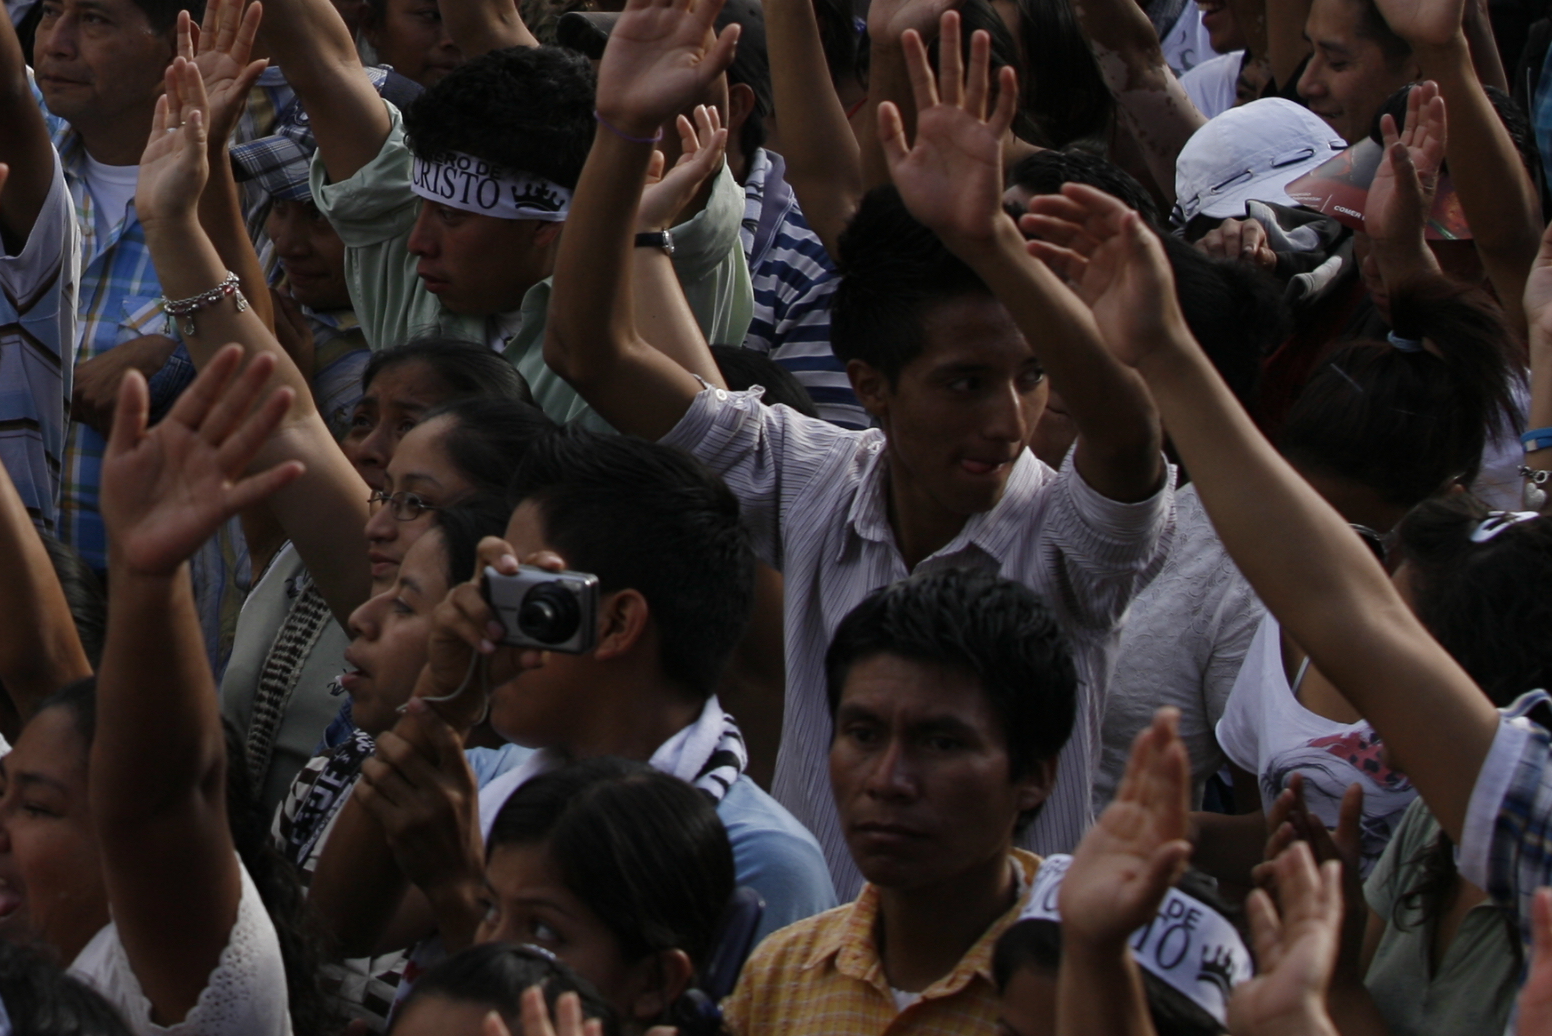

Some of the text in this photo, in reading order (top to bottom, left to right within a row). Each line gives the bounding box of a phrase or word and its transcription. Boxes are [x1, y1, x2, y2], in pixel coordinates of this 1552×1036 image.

[413, 155, 500, 210] CRISTO
[476, 161, 502, 180] DE
[1333, 205, 1362, 220] COMER
[1167, 898, 1203, 932] DE
